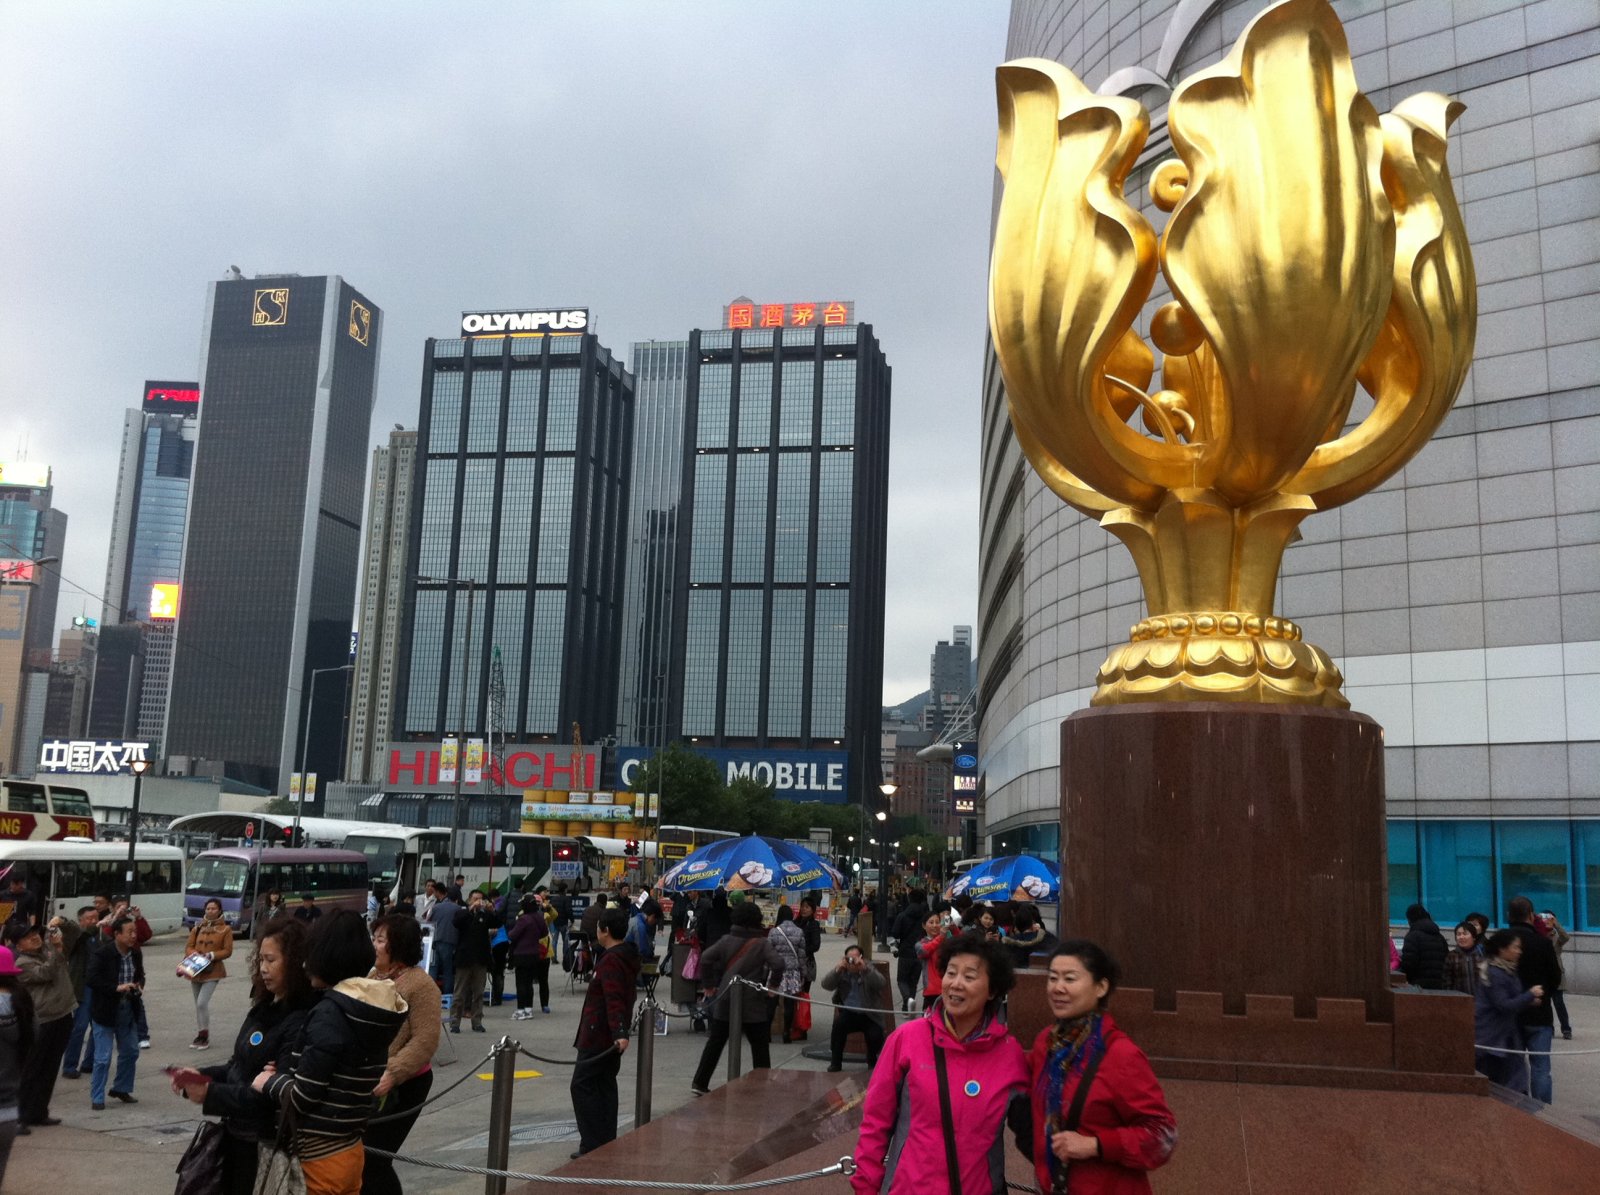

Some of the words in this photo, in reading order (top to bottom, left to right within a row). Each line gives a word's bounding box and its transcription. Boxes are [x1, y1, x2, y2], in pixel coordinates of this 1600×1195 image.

[462, 311, 587, 332] OLYMPUS
[729, 302, 847, 329] 国酒茅台
[726, 761, 843, 791] MOBILE
[678, 868, 722, 885] Drumstick
[786, 868, 823, 886] Drumstick
